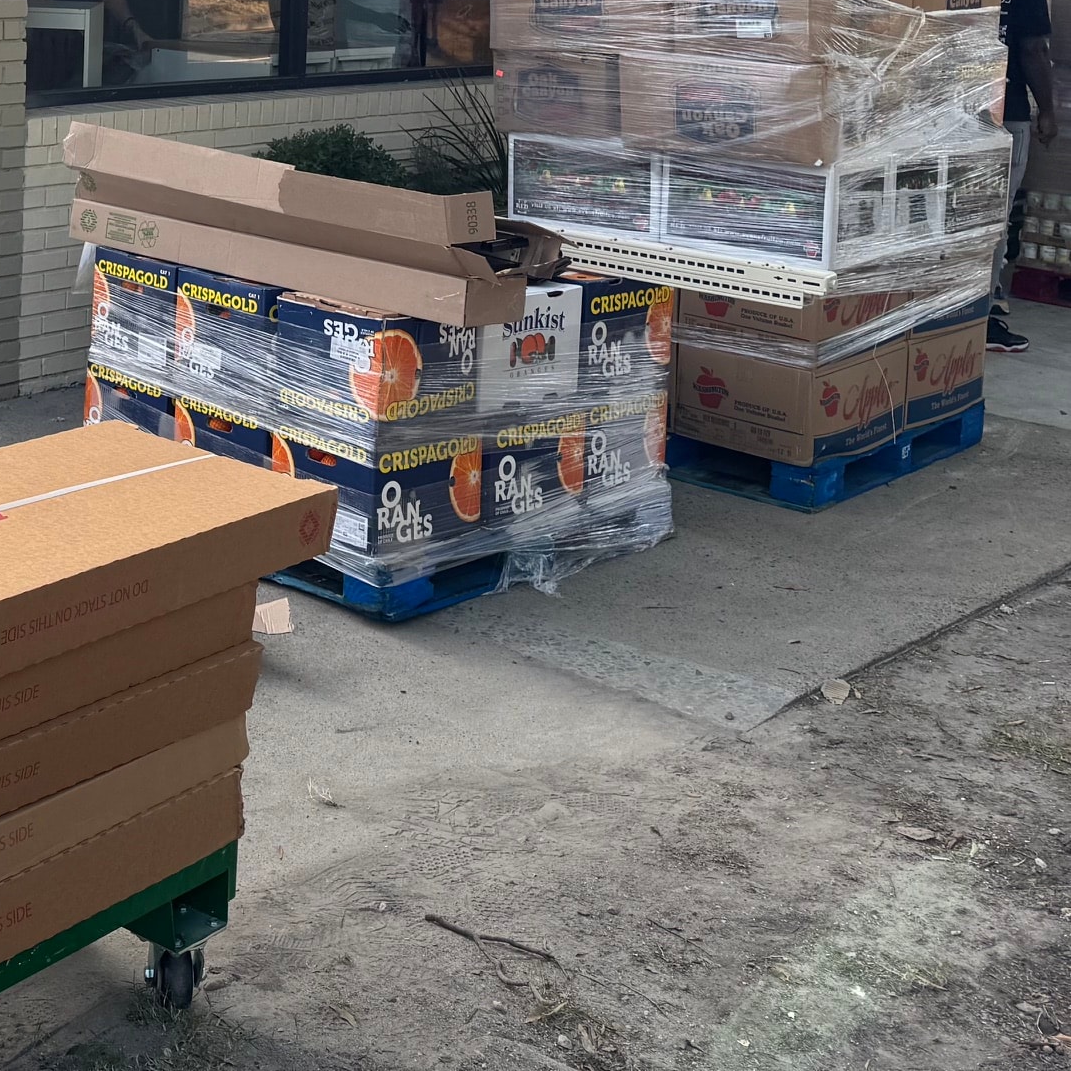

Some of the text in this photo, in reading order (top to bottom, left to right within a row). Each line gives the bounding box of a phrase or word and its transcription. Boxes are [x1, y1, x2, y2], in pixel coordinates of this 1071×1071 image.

[467, 200, 479, 235] 90338
[98, 259, 169, 290] CRISPAGOLD
[182, 281, 259, 314] CRISPAGOLD
[591, 284, 671, 315] CRISPAGOLD
[741, 308, 768, 319] PRODUCE
[502, 305, 566, 338] Sunkist
[90, 363, 162, 399] CRISPAGOLD
[693, 382, 730, 397] WASHINGTON
[180, 393, 259, 430] CRISPAGOLD
[385, 381, 475, 422] CRISPAGOLD
[589, 392, 665, 425] CRISPAGOLD
[930, 402, 941, 410] The
[279, 425, 367, 463] CRISPAGOLD
[496, 413, 582, 449] CRISPAGOLD
[845, 436, 855, 446] The
[379, 434, 479, 474] CRISPAGOLD
[0, 579, 149, 646] DO NOT STACK ON THIS SIDE
[14, 684, 40, 706] SIDE
[14, 761, 41, 783] SIDE
[9, 822, 34, 848] SIDE
[5, 902, 33, 928] SIDE
